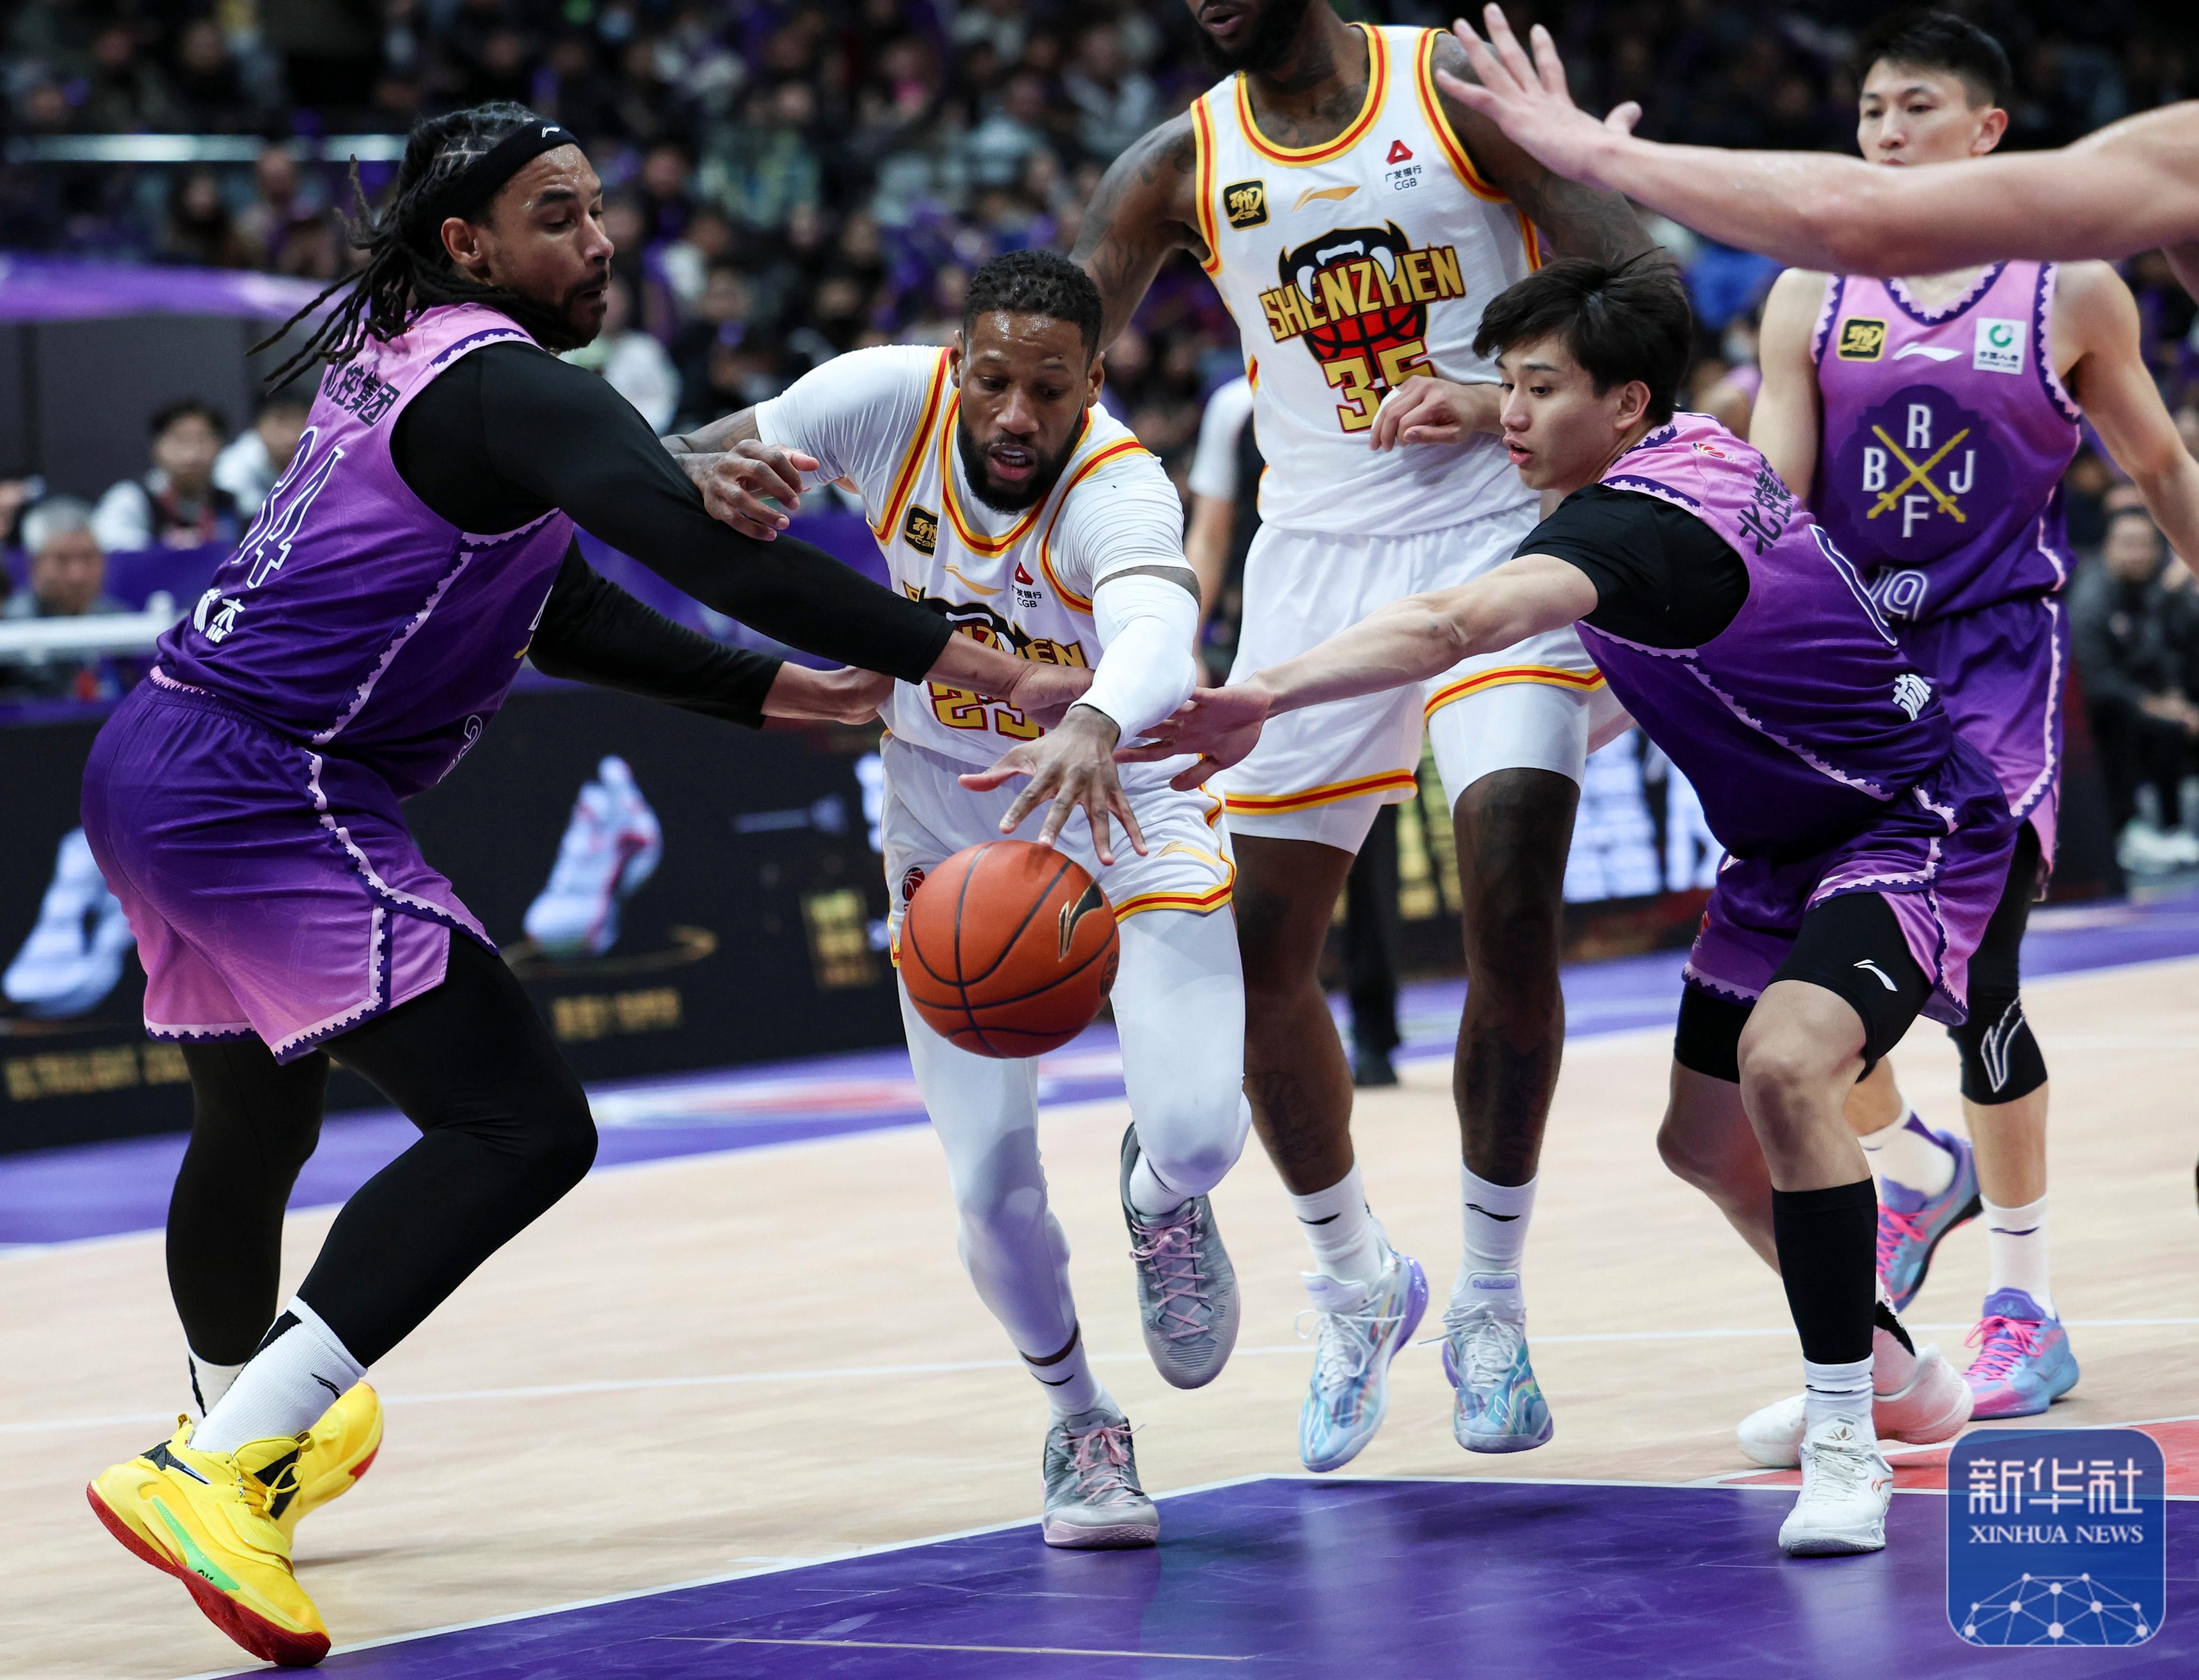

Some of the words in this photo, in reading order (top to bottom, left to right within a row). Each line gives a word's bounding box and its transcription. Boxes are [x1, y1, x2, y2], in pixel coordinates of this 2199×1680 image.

[1385, 165, 1422, 182] 广发银行
[1394, 178, 1417, 190] CGB
[1259, 244, 1466, 344] SHENZHEN
[1906, 404, 1931, 449] R
[1862, 446, 1888, 492] B
[1949, 450, 1975, 494] J
[1902, 494, 1930, 538] F
[1017, 598, 1037, 608] CGB
